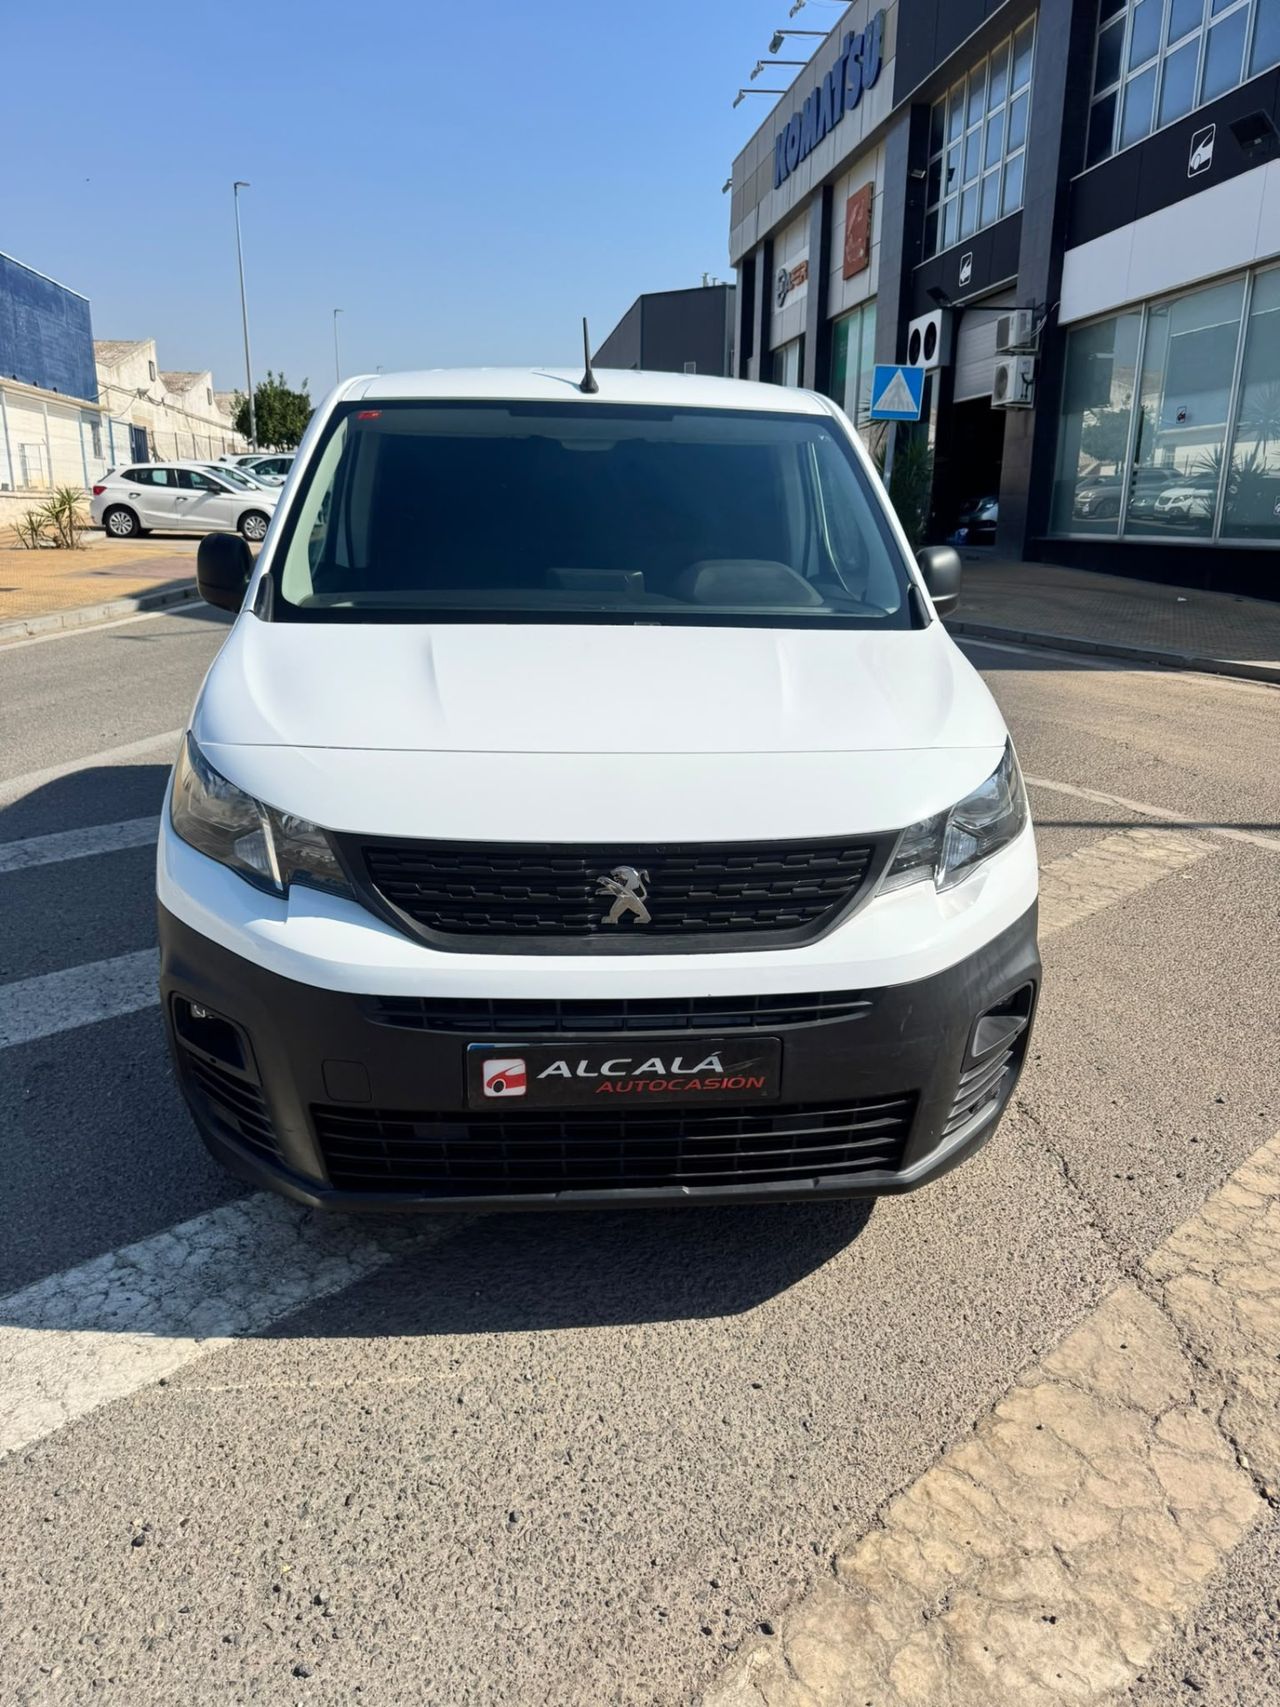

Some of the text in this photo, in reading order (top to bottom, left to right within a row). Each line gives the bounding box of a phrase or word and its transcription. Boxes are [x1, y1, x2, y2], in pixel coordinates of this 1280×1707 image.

[774, 9, 885, 190] KOMATSU
[536, 1051, 724, 1079] ALCALÁ
[596, 1074, 766, 1094] AUTOCASIÓN
